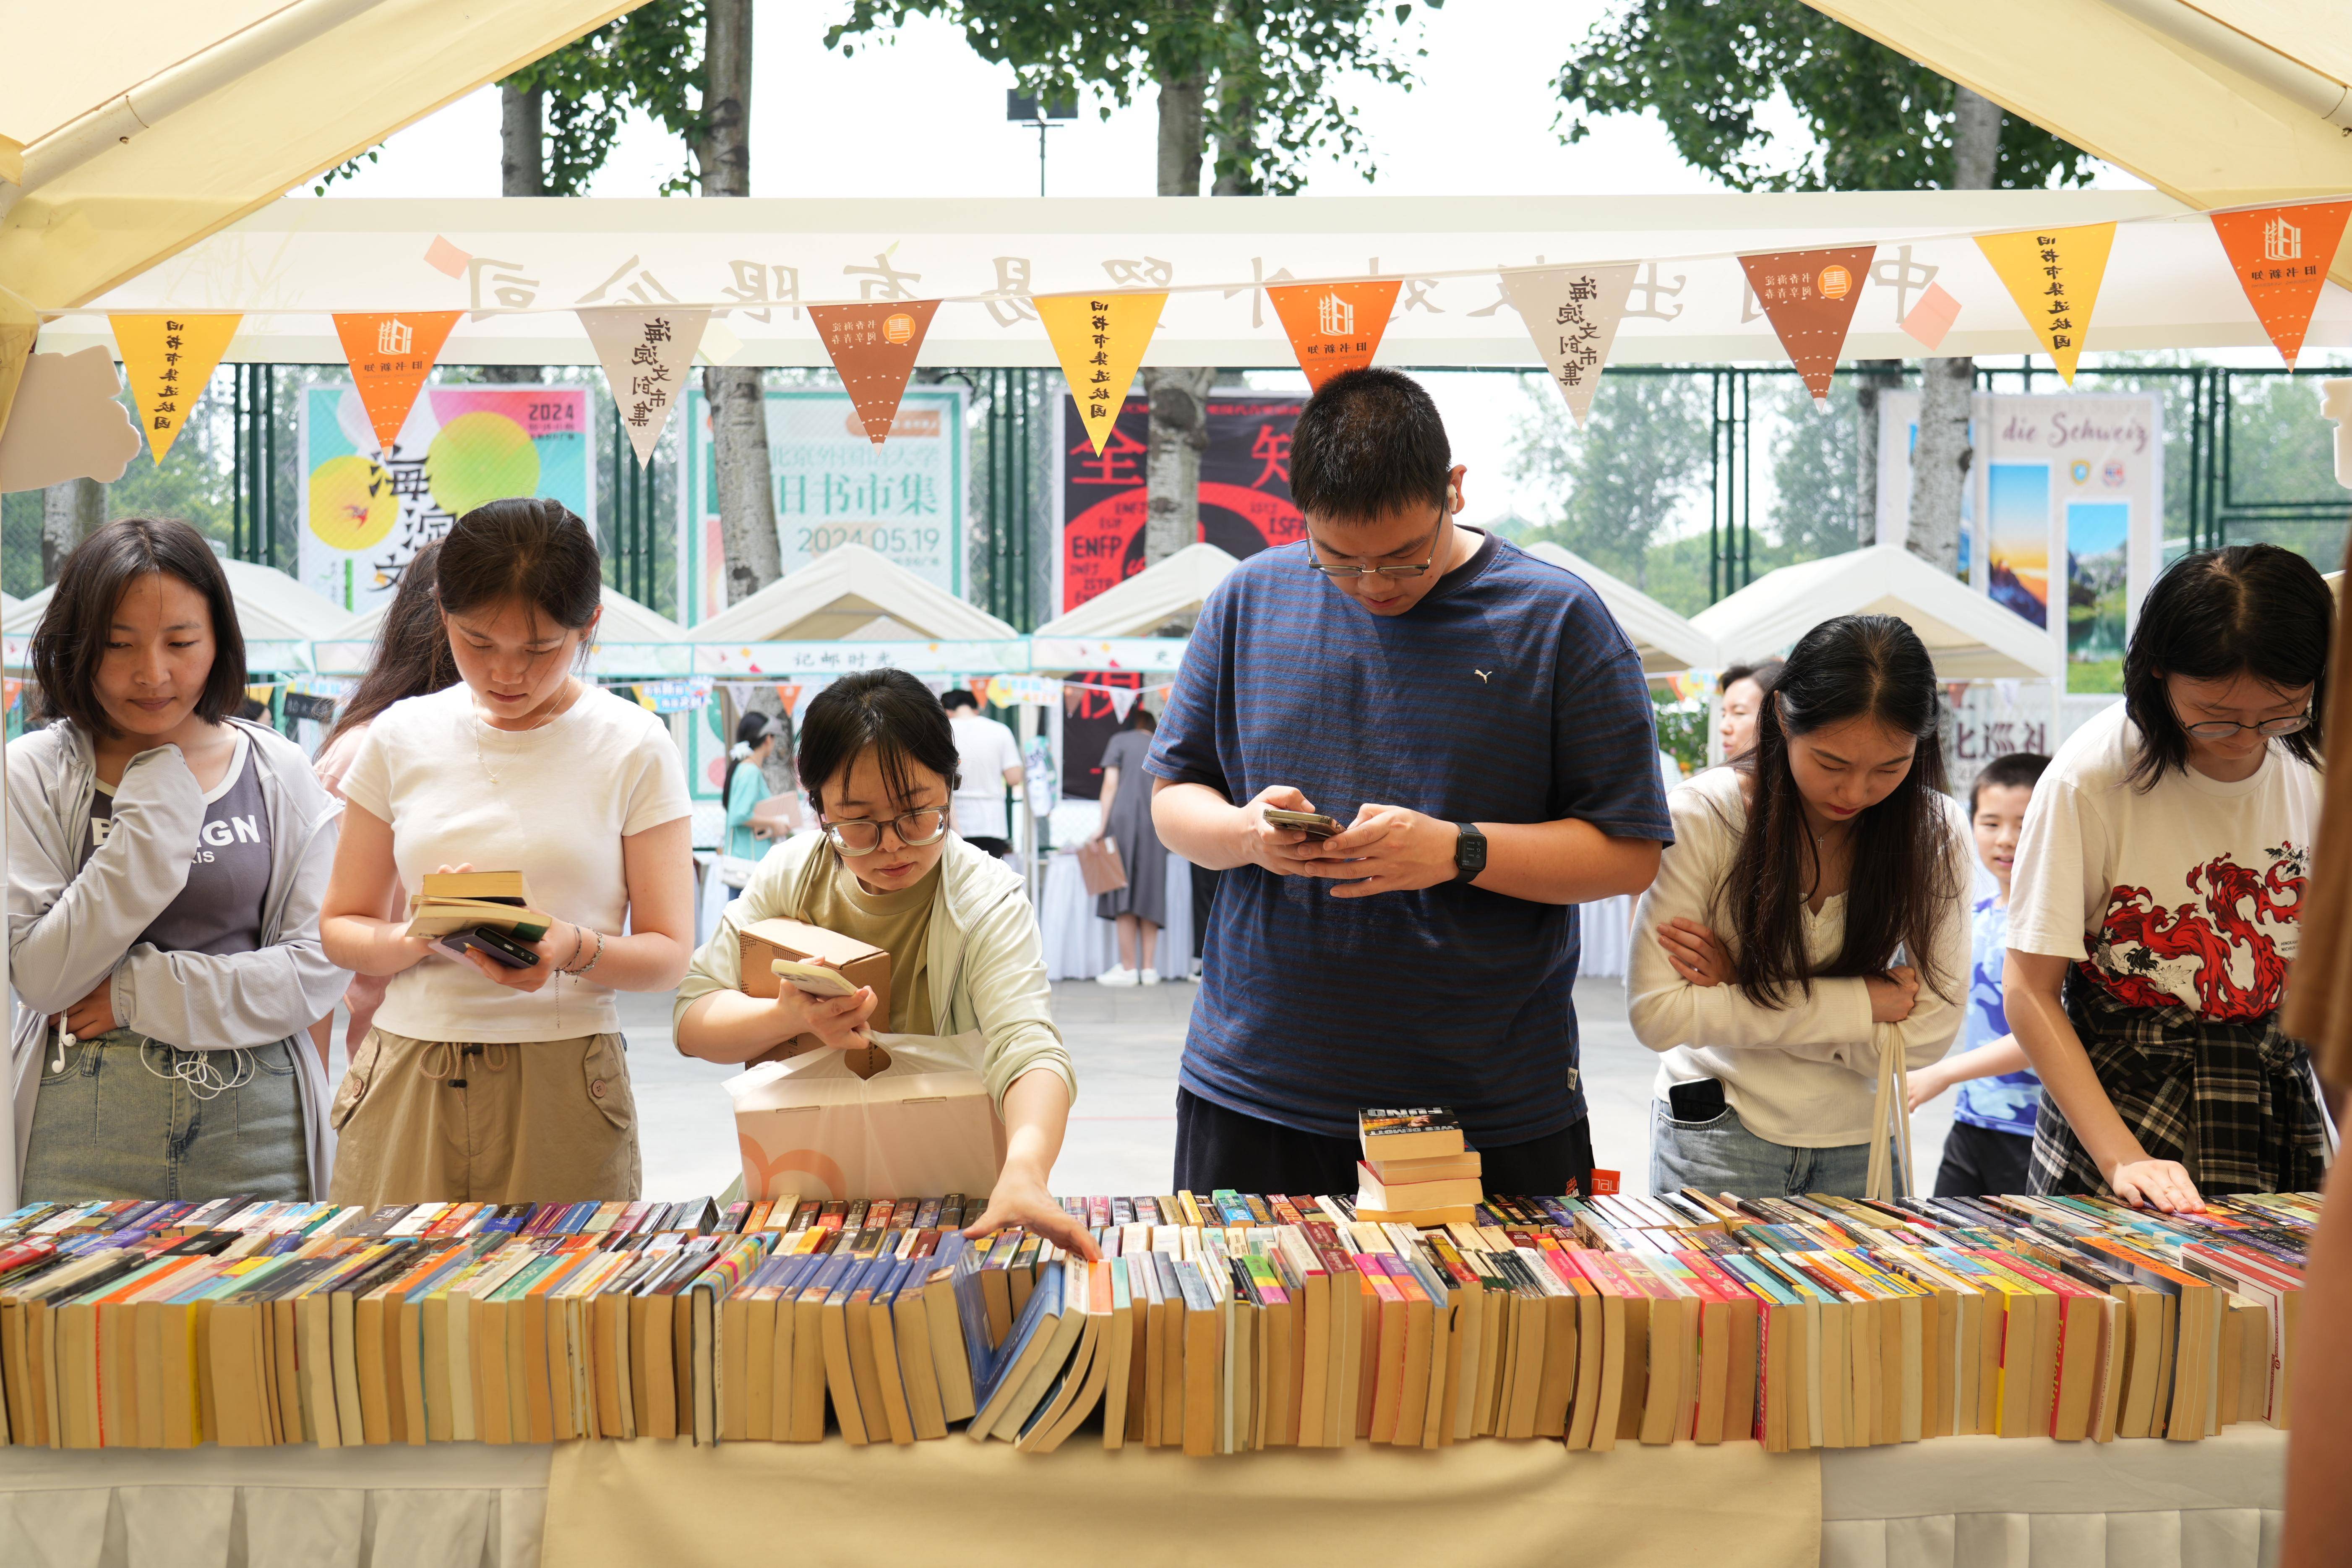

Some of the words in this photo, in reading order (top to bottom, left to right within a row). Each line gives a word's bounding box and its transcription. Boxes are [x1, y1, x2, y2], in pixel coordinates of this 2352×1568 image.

[529, 403, 574, 420] 2024
[2003, 416, 2036, 442] die
[2047, 412, 2148, 454] Schweiz
[1073, 535, 1122, 559] ENFP
[1367, 1107, 1443, 1116] FUND
[1369, 1127, 1421, 1135] DEMOTT
[1591, 1178, 1619, 1192] nau
[2099, 1244, 2164, 1271] SUBMARINE
